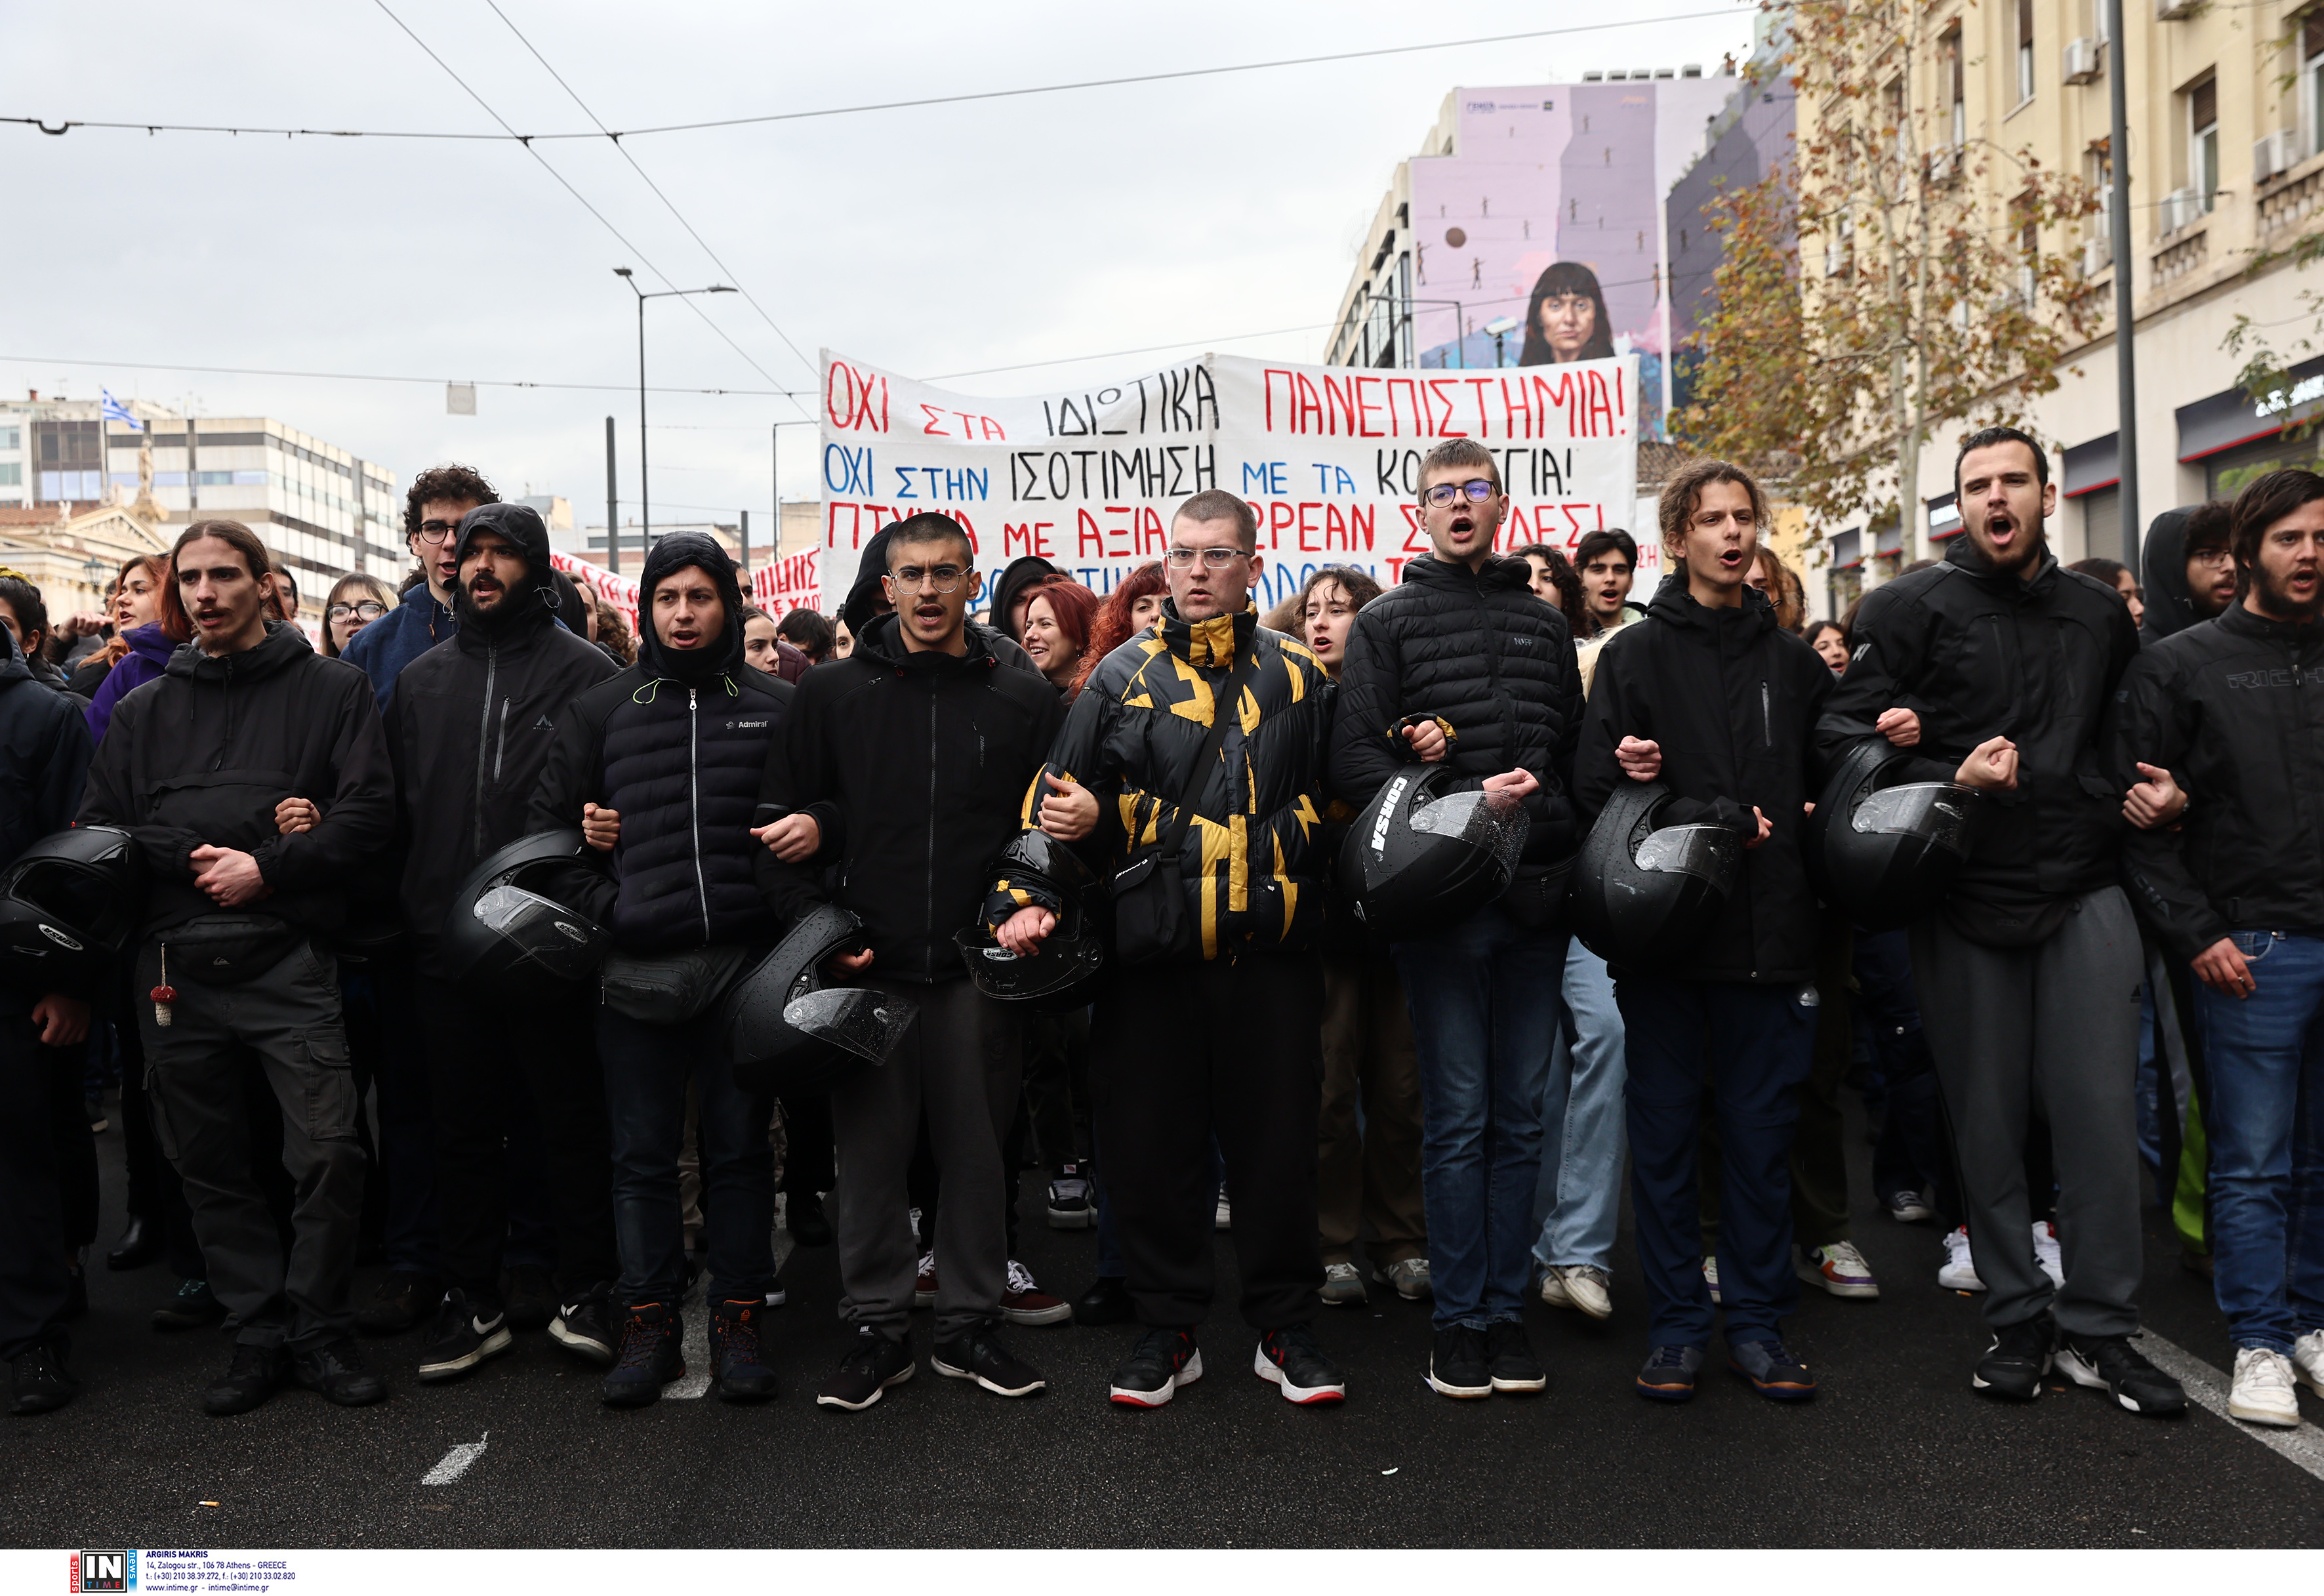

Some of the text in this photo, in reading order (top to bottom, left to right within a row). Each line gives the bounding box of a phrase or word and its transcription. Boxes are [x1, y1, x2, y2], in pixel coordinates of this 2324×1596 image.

[827, 361, 1627, 441] ΟΧΙ ΣΤΑ ΙΔΙΩΤΙΚΑ ΠΑΝΕΠΙΣΤΗΜΙΑ!
[825, 443, 1572, 501] ΟΧΙ ΣΤΗΝ ΙΣΟΤΙΜΗΣΗ ΜΕ ΤΑ ΚΟΓΙΑ!
[1004, 522, 1055, 558] ΜΕ
[1078, 506, 1168, 558] ΑΞΙΑ
[1371, 777, 1408, 851] CORSA
[42, 926, 80, 949] CORSA
